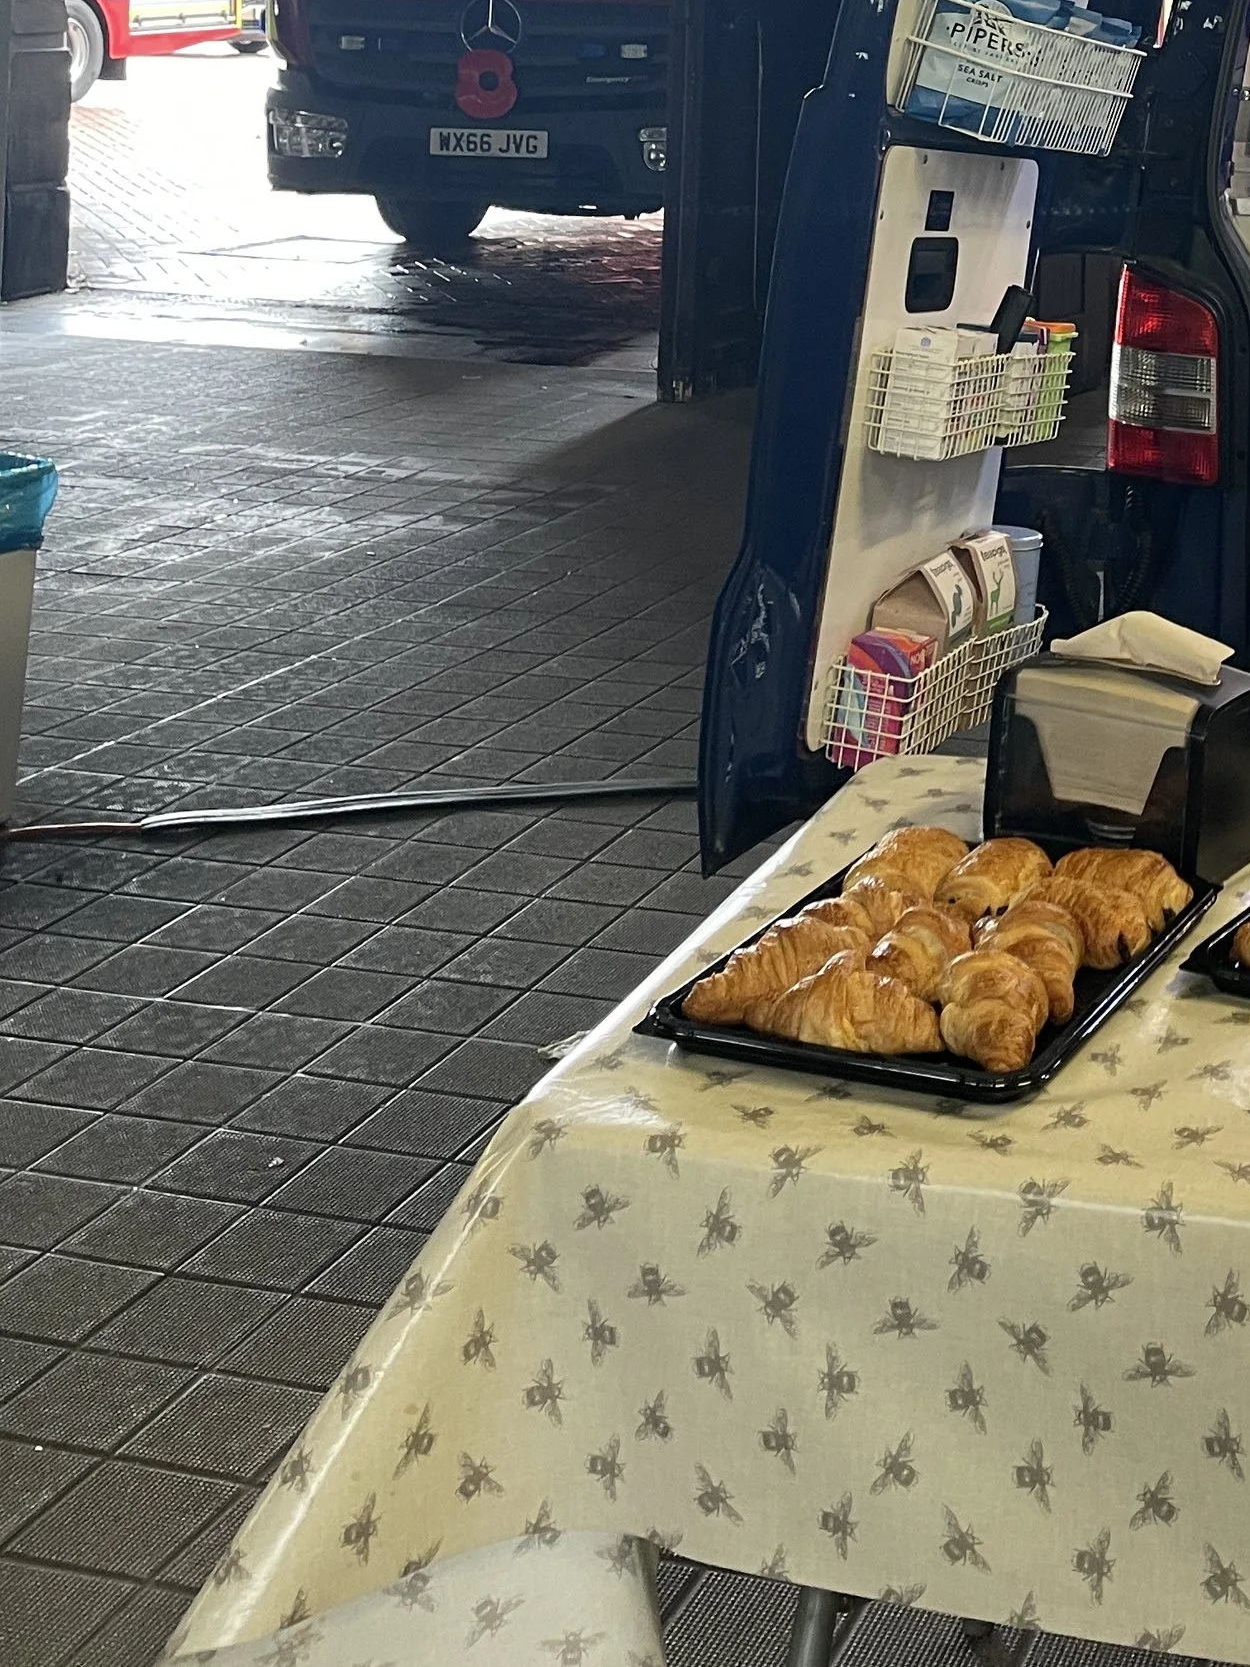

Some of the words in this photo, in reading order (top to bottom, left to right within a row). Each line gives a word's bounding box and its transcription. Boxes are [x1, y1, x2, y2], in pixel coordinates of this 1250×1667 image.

[950, 22, 1025, 58] PIPERS
[957, 64, 976, 76] SEA
[979, 70, 1003, 83] SALT
[439, 131, 492, 153] WX66
[498, 134, 538, 155] JVG
